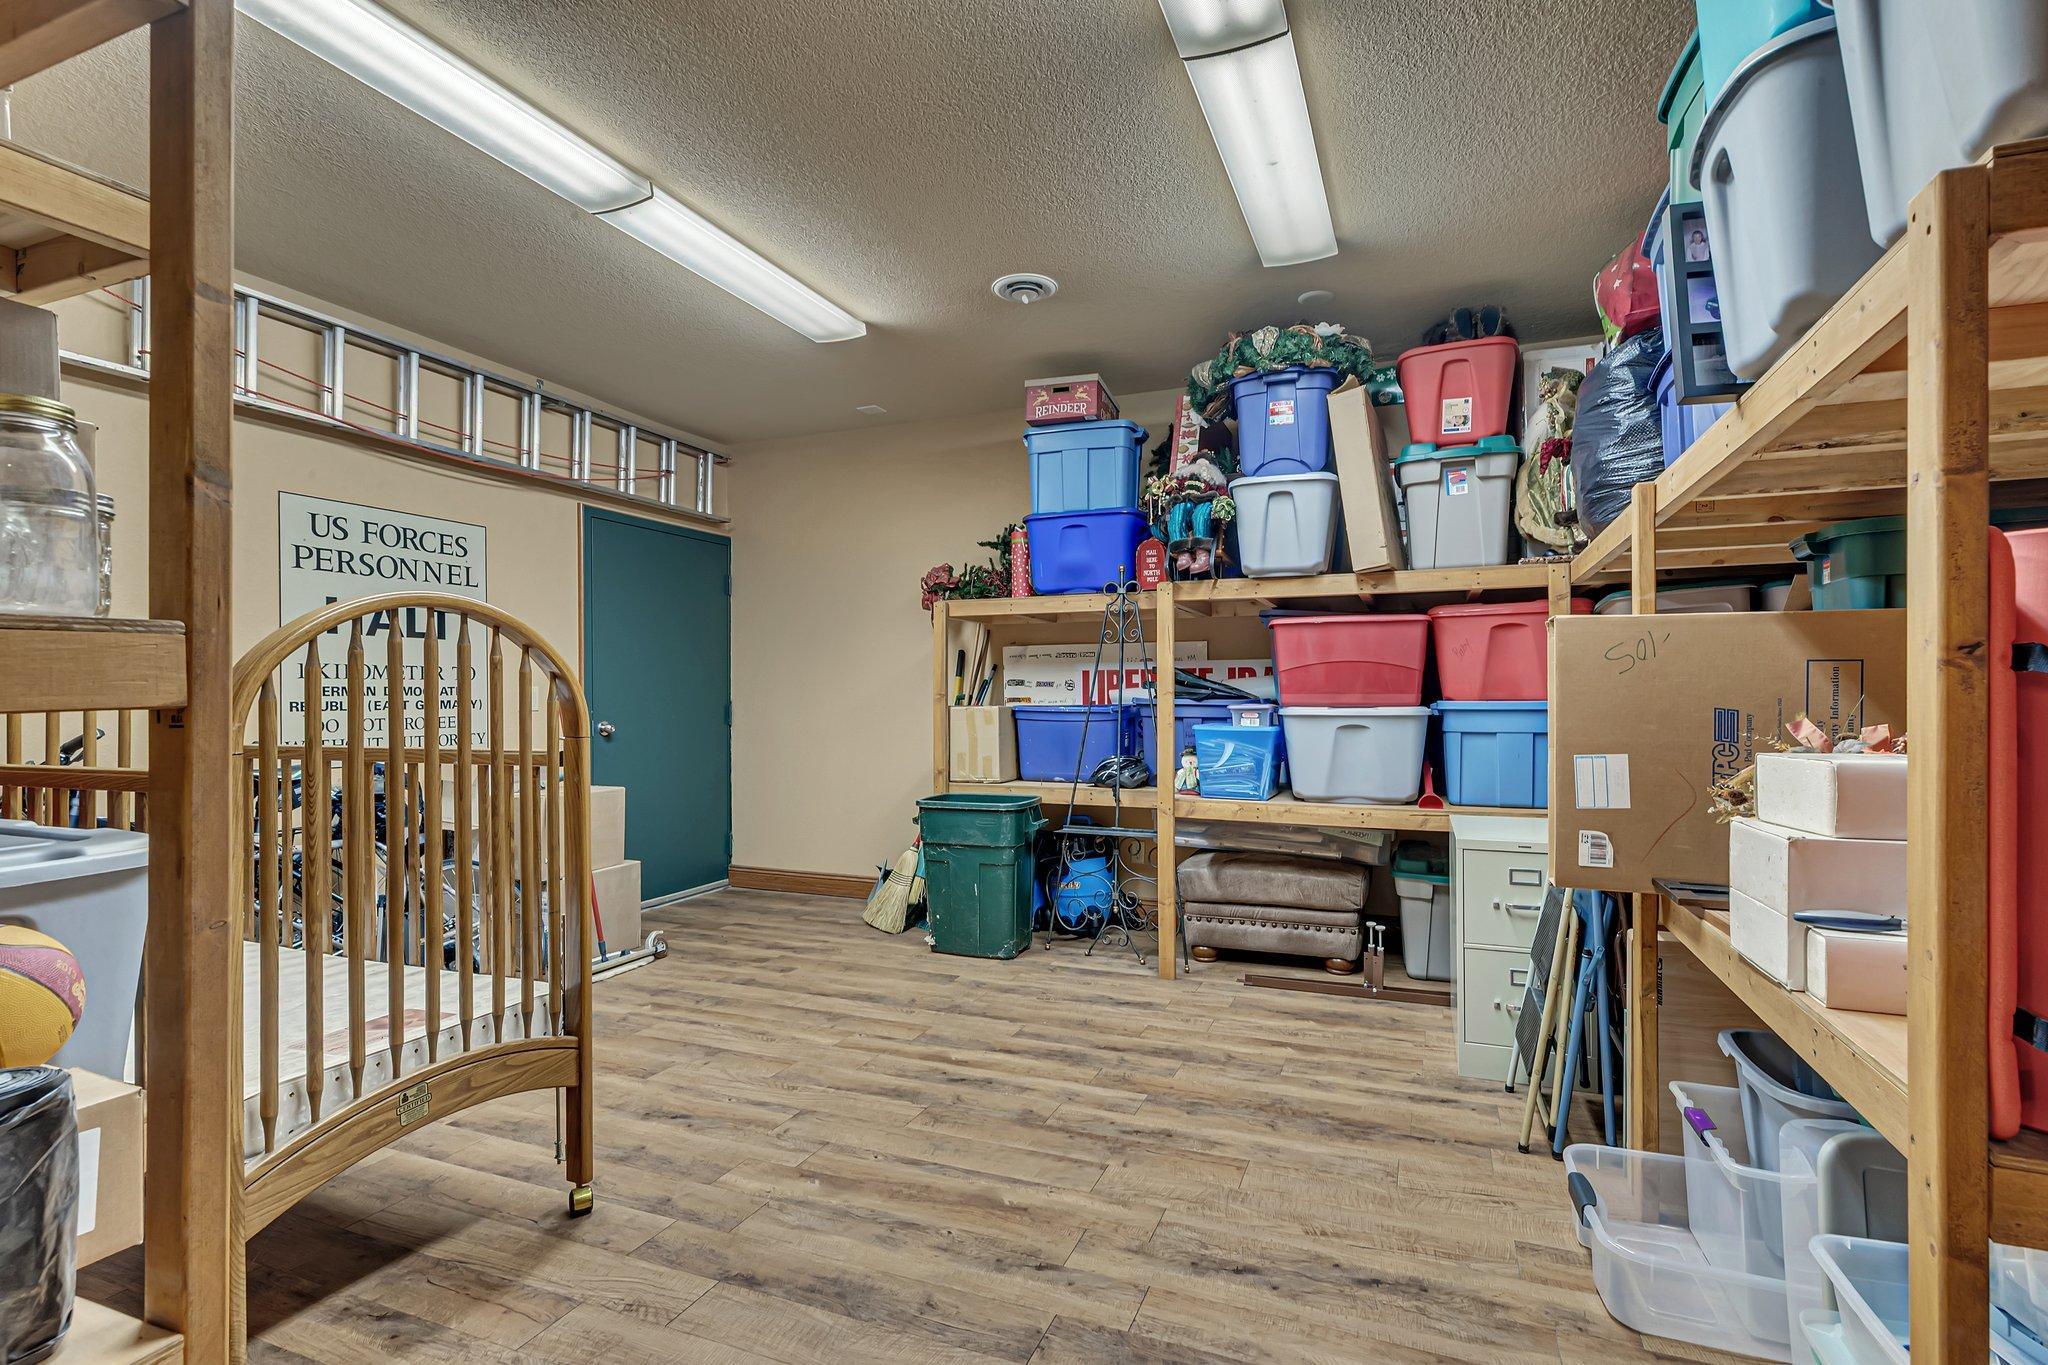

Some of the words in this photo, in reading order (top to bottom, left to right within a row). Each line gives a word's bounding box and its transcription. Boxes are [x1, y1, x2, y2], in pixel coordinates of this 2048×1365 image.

[1035, 402, 1087, 418] REINDEER
[306, 511, 349, 542] US
[360, 519, 468, 558] FORCES
[290, 543, 479, 588] PERSONNEL
[326, 596, 446, 640] ALT
[367, 699, 409, 712] (EAT
[1830, 666, 1839, 720] Information
[362, 716, 386, 731] OT
[1743, 713, 1754, 748] Company
[1744, 749, 1752, 762] Pad
